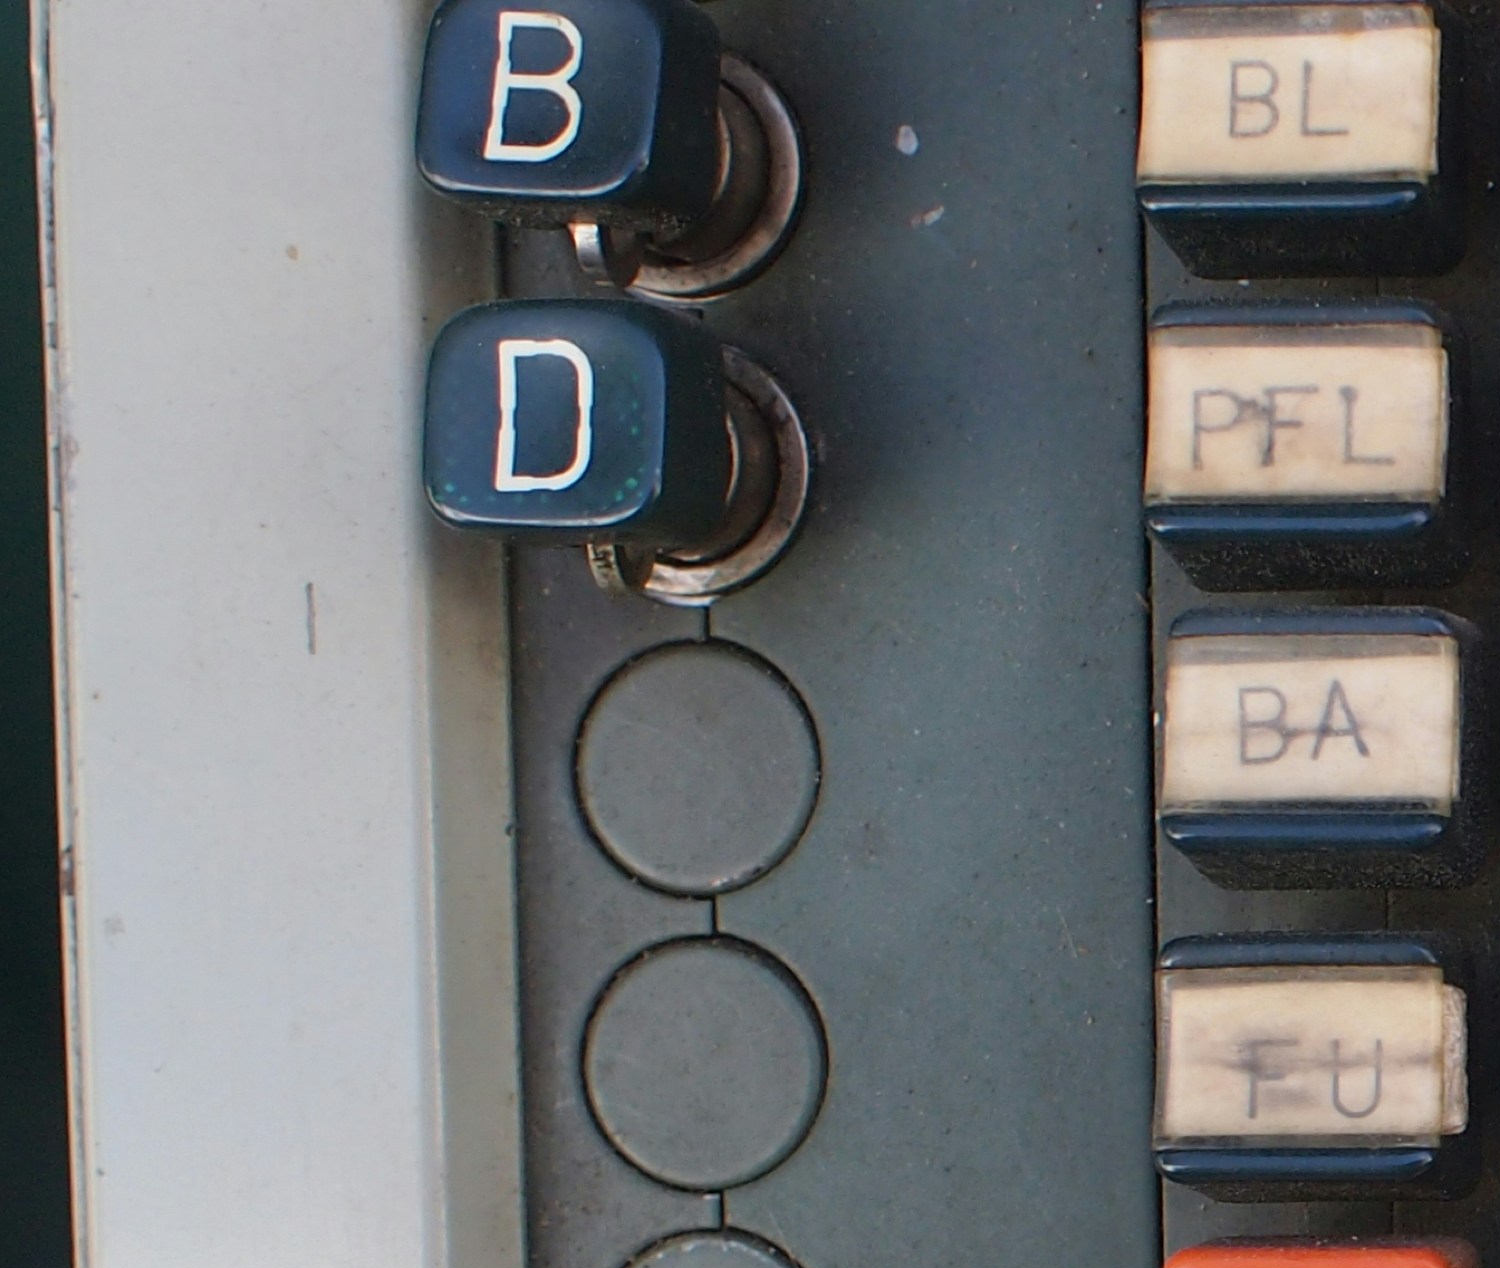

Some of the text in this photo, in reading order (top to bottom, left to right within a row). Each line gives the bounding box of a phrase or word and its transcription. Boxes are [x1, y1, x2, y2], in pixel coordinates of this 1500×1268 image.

[483, 11, 584, 162] B
[1227, 59, 1349, 139] BL
[494, 337, 594, 493] D
[1191, 384, 1396, 471] PFL
[1237, 679, 1370, 767] BA
[1245, 1037, 1384, 1119] FU
